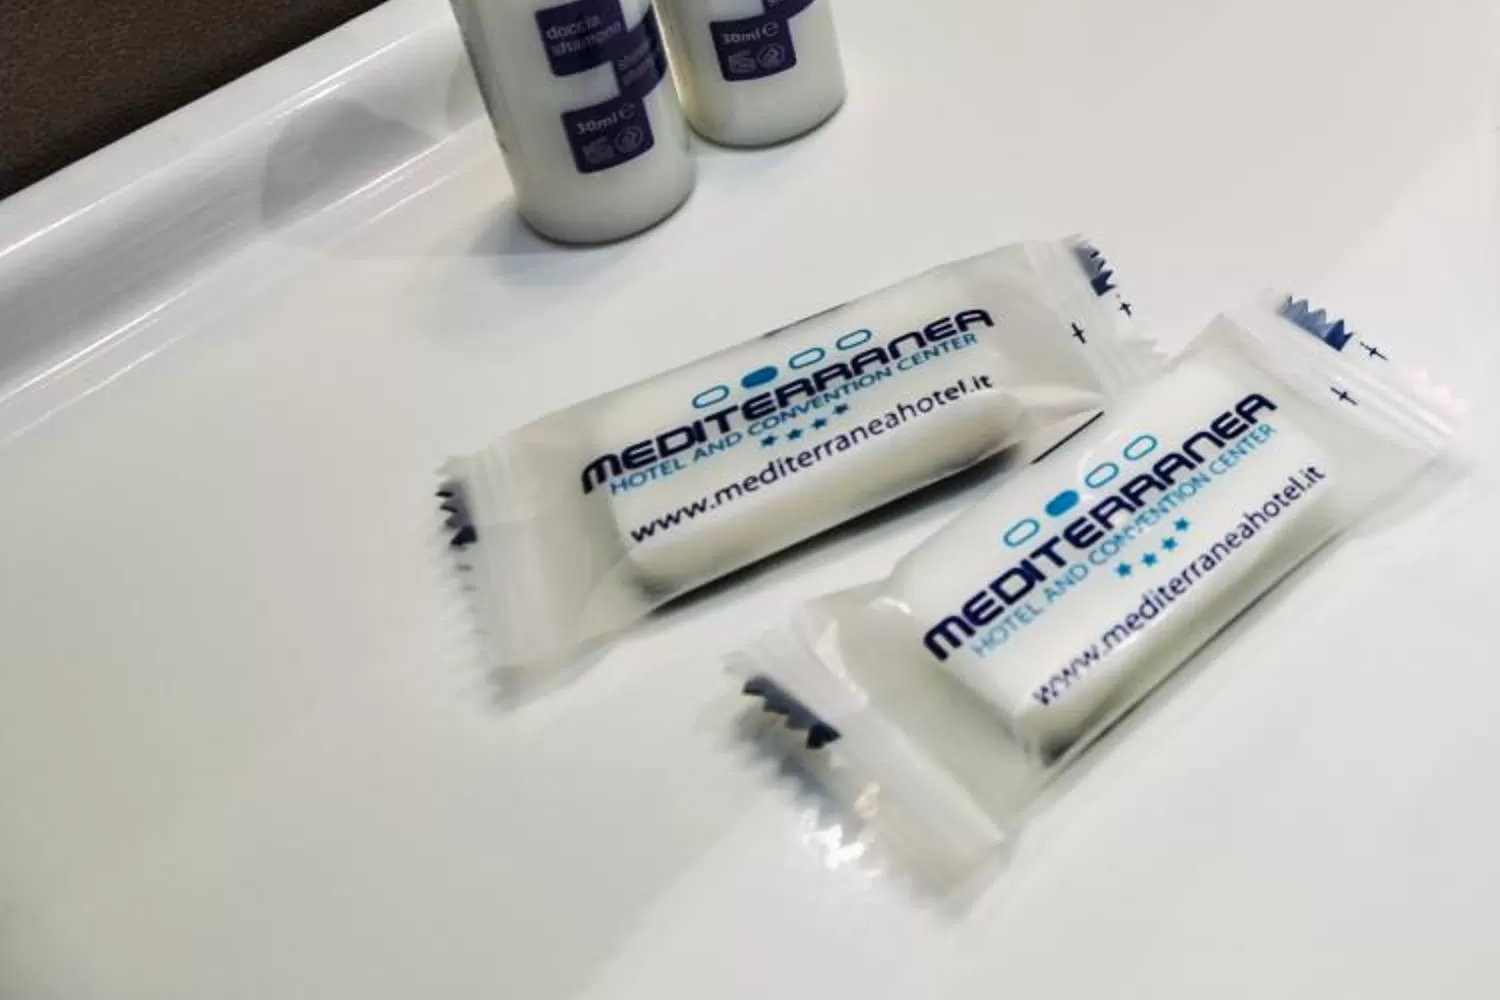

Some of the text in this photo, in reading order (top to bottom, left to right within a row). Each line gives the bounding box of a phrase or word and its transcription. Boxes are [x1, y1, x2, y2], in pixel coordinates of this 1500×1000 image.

[546, 14, 600, 41] doccia
[551, 21, 623, 56] shampoo
[575, 112, 619, 136] 30ml
[580, 307, 996, 496] MEDITERRANEA
[608, 332, 979, 496] HOTEL AND CONVENTION CENTER
[630, 373, 994, 544] www.mediterraneahotel.it
[922, 391, 1279, 663] MEDITERRANEA
[970, 423, 1279, 660] HOTEL AND CONVENTION CENTER
[1031, 463, 1327, 708] www.mediterraneahotel.it
